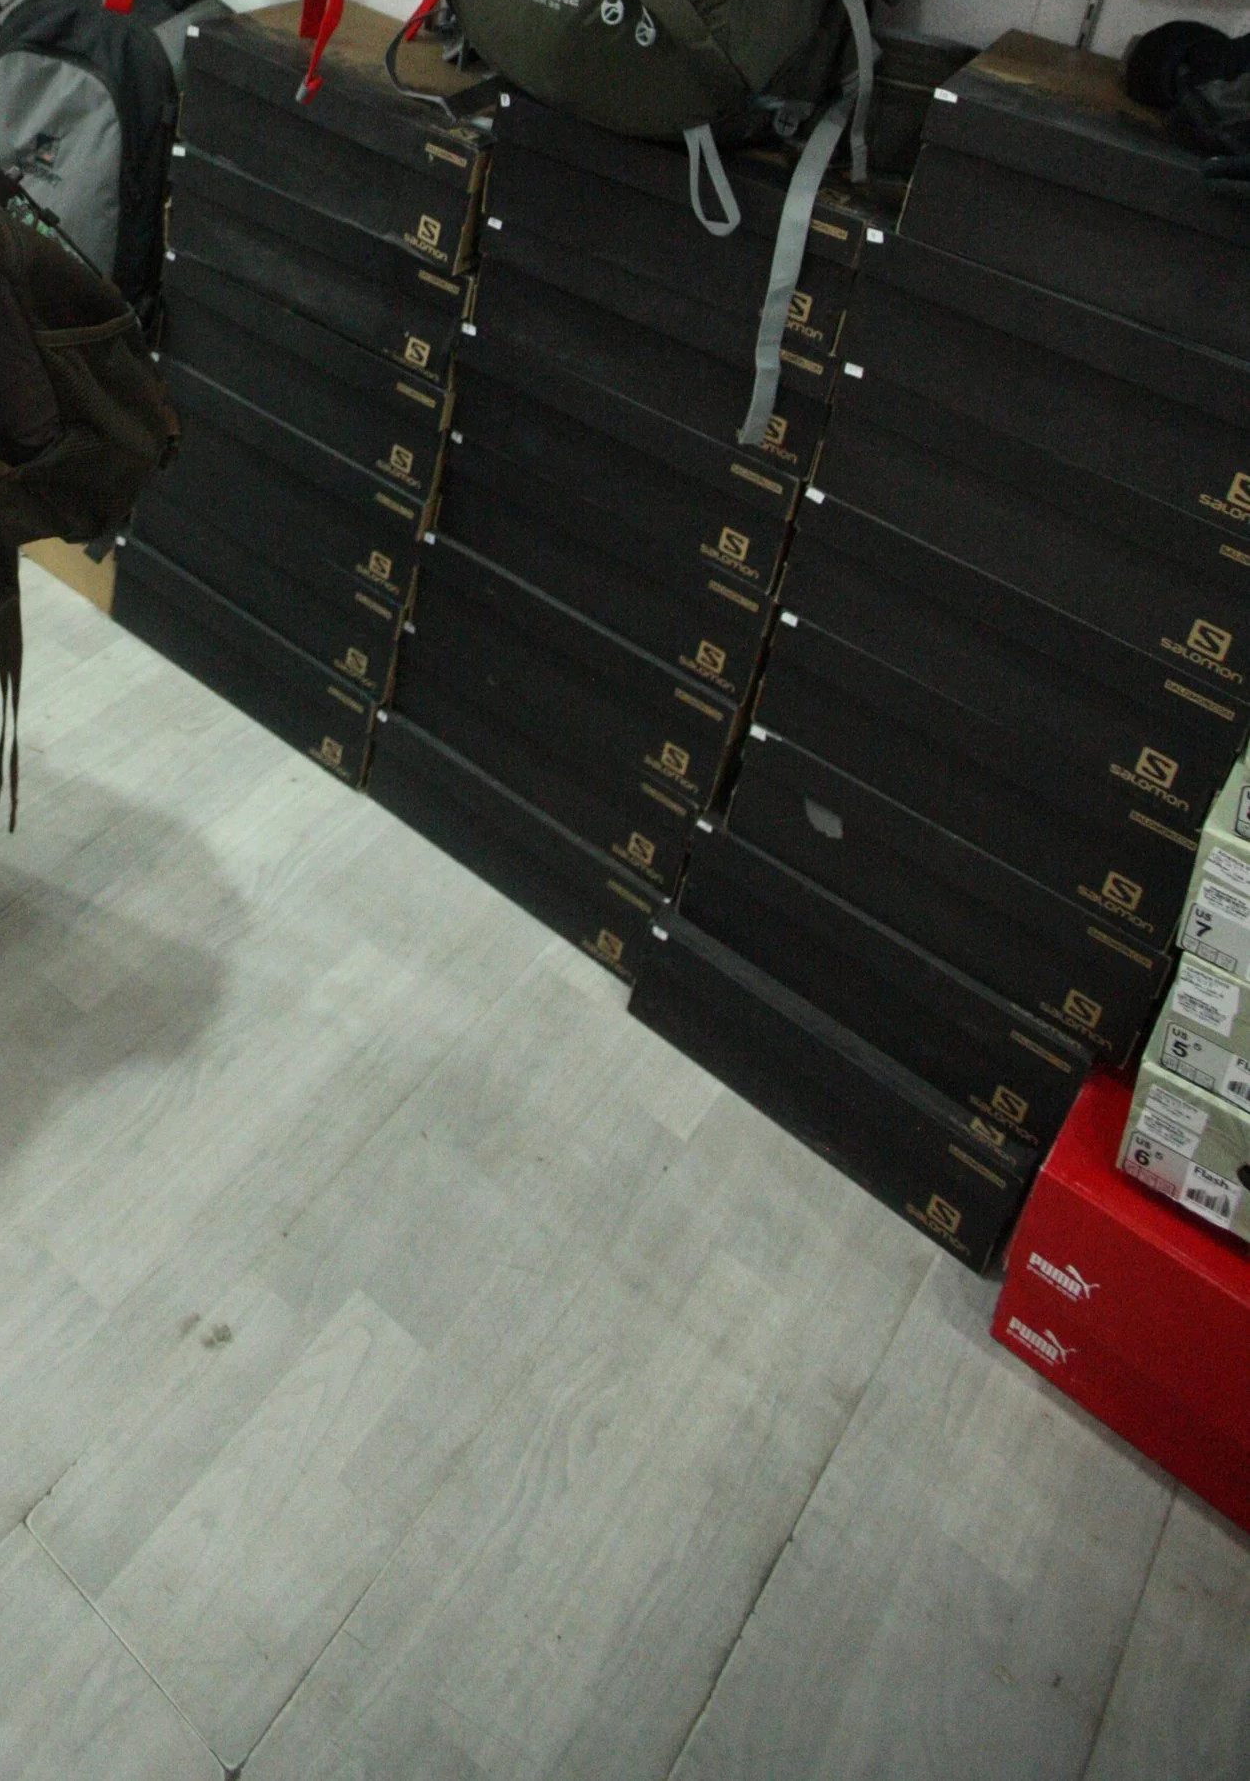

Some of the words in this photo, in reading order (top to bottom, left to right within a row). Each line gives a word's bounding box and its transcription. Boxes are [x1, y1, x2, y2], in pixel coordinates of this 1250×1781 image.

[1160, 636, 1242, 685] salomon
[1110, 763, 1190, 812] salomon
[1078, 884, 1155, 934] salomon
[1195, 908, 1212, 922] US
[1195, 920, 1212, 937] 7
[1172, 1027, 1189, 1041] US
[1172, 1040, 1189, 1058] 5
[1135, 1135, 1151, 1150] US
[1134, 1148, 1151, 1167] 6
[1193, 1165, 1230, 1191] Flash
[1029, 1251, 1083, 1297] PUMA
[1009, 1315, 1059, 1361] PUMA
